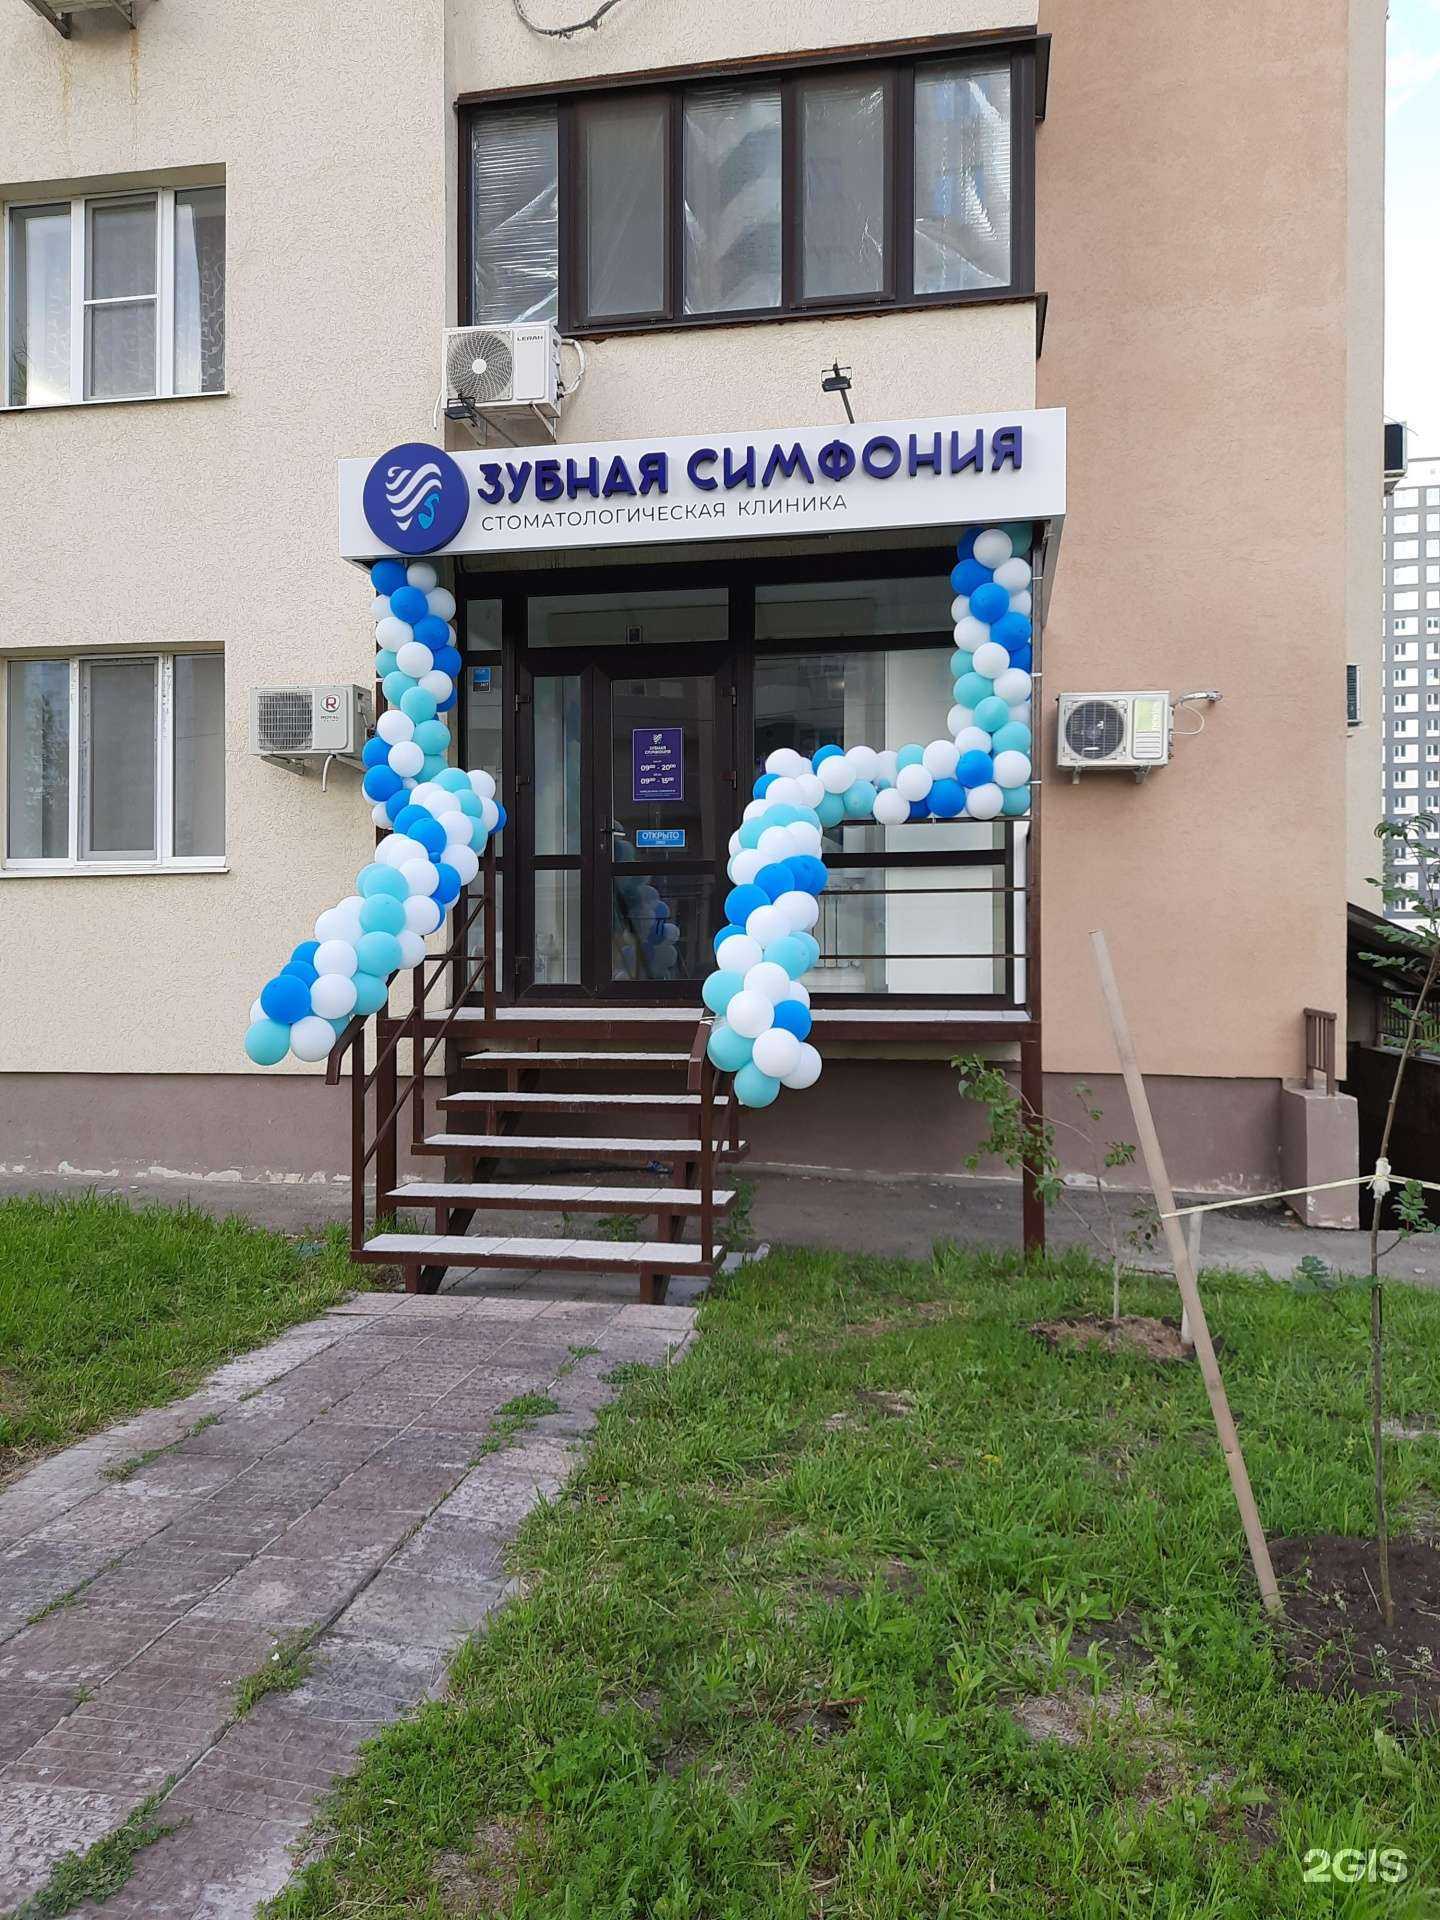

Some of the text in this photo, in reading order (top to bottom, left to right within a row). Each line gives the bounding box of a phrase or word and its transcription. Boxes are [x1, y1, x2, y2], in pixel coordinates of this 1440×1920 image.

[477, 425, 1023, 504] ЗУБНАЯ СИМФОНИЯ
[481, 494, 848, 532] СТОМАТОЛОГИЧЕСКАЯ КЛИНИКА
[326, 697, 337, 709] R
[641, 831, 680, 840] ОТКРЫТО
